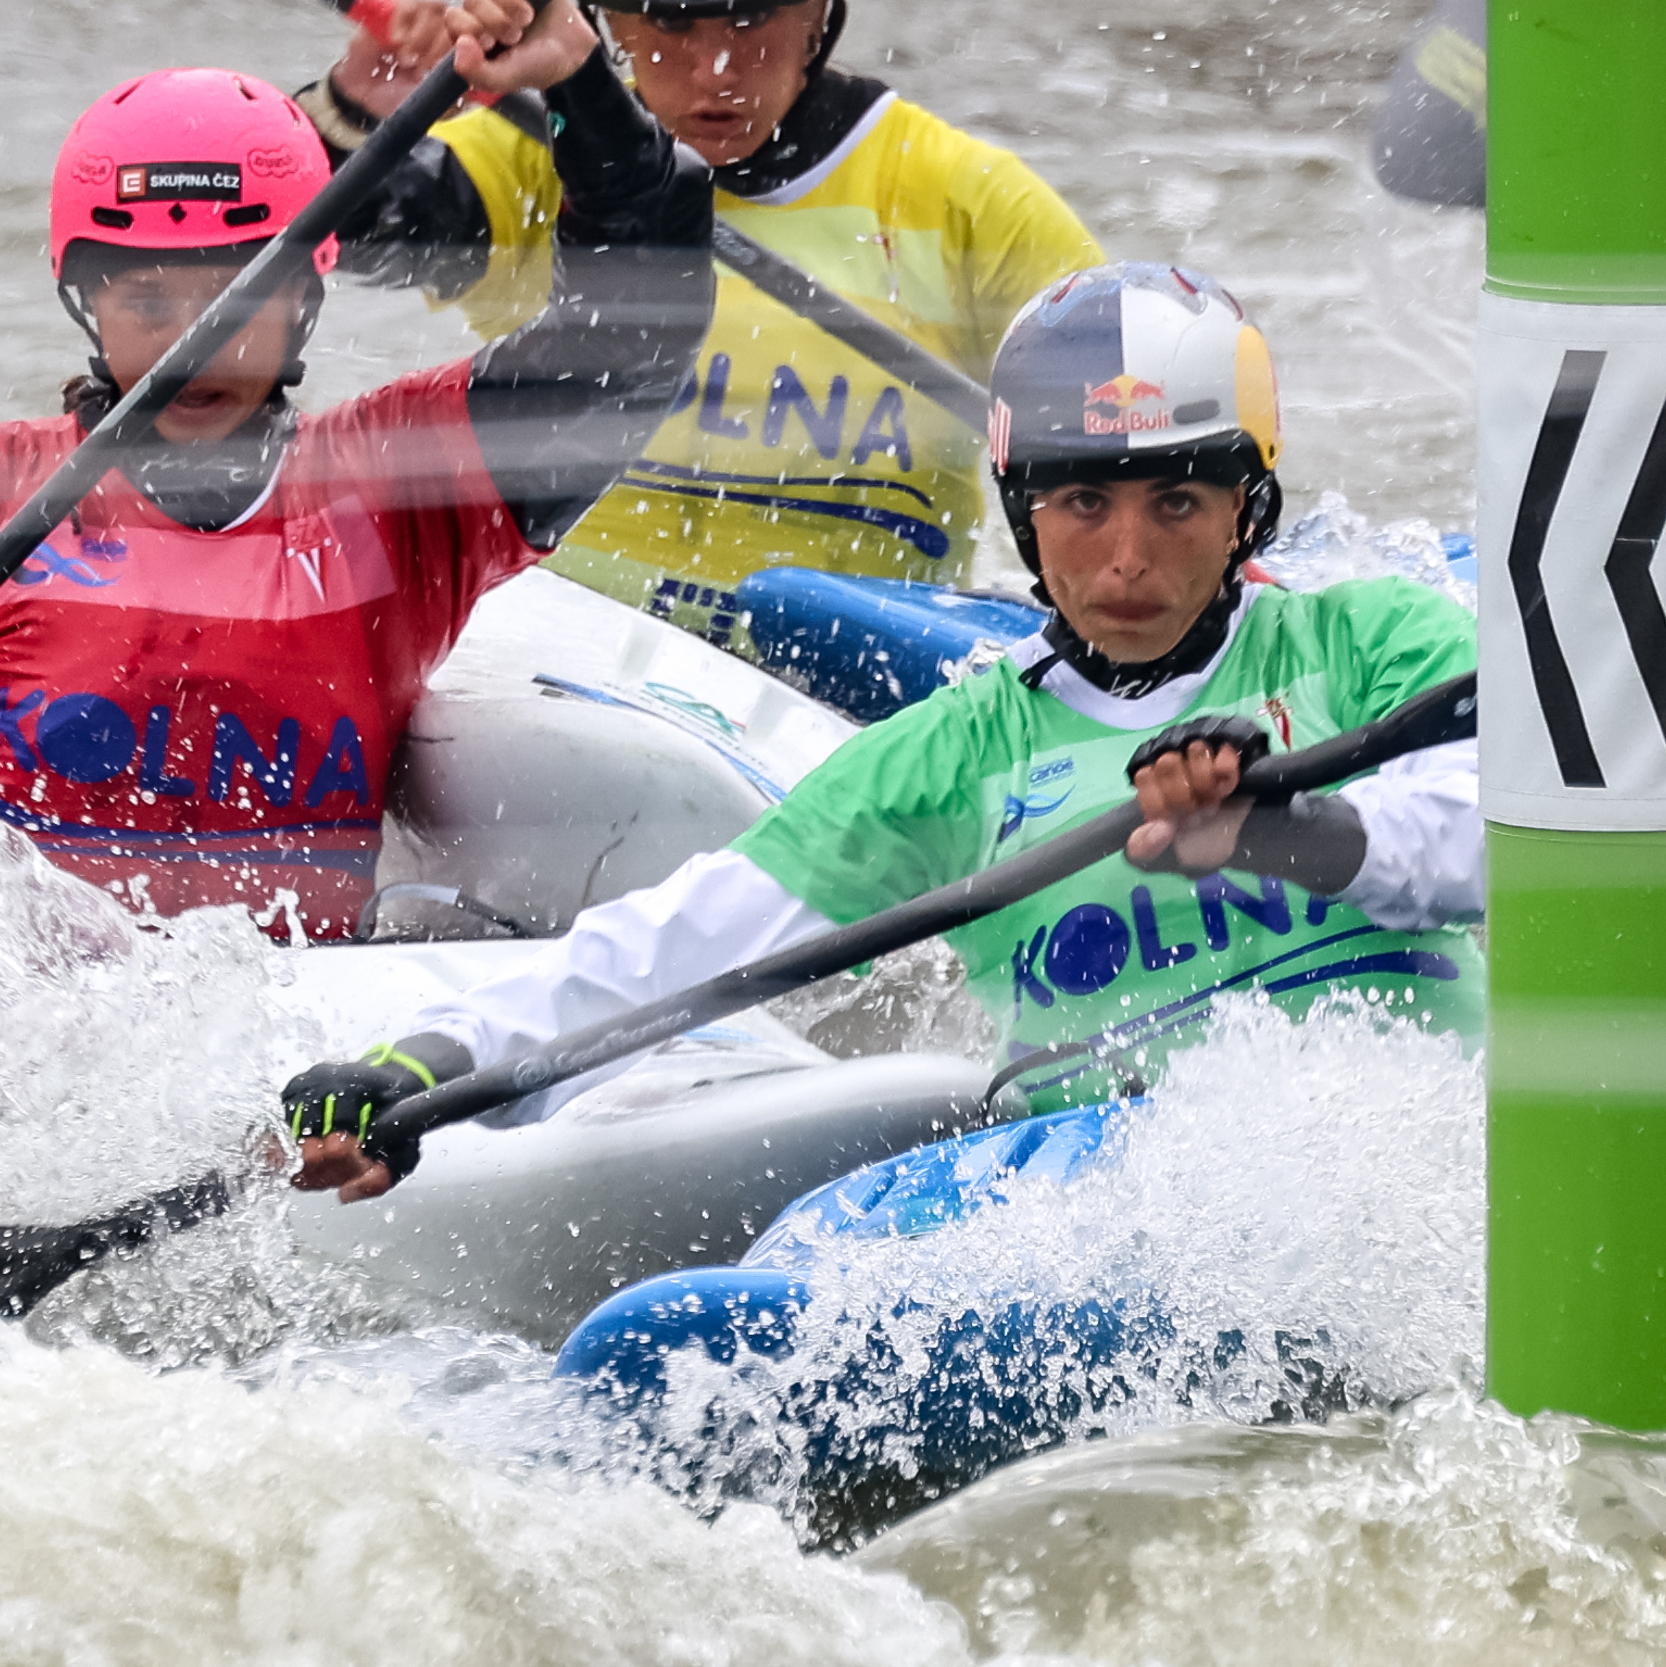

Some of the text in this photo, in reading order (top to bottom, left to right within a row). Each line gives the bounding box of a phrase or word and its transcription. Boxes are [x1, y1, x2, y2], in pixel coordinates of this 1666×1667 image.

[150, 174, 211, 188] SKUPINA
[212, 170, 240, 189] ČEZ
[666, 352, 913, 472] LNA
[1084, 407, 1171, 435] Red Bull
